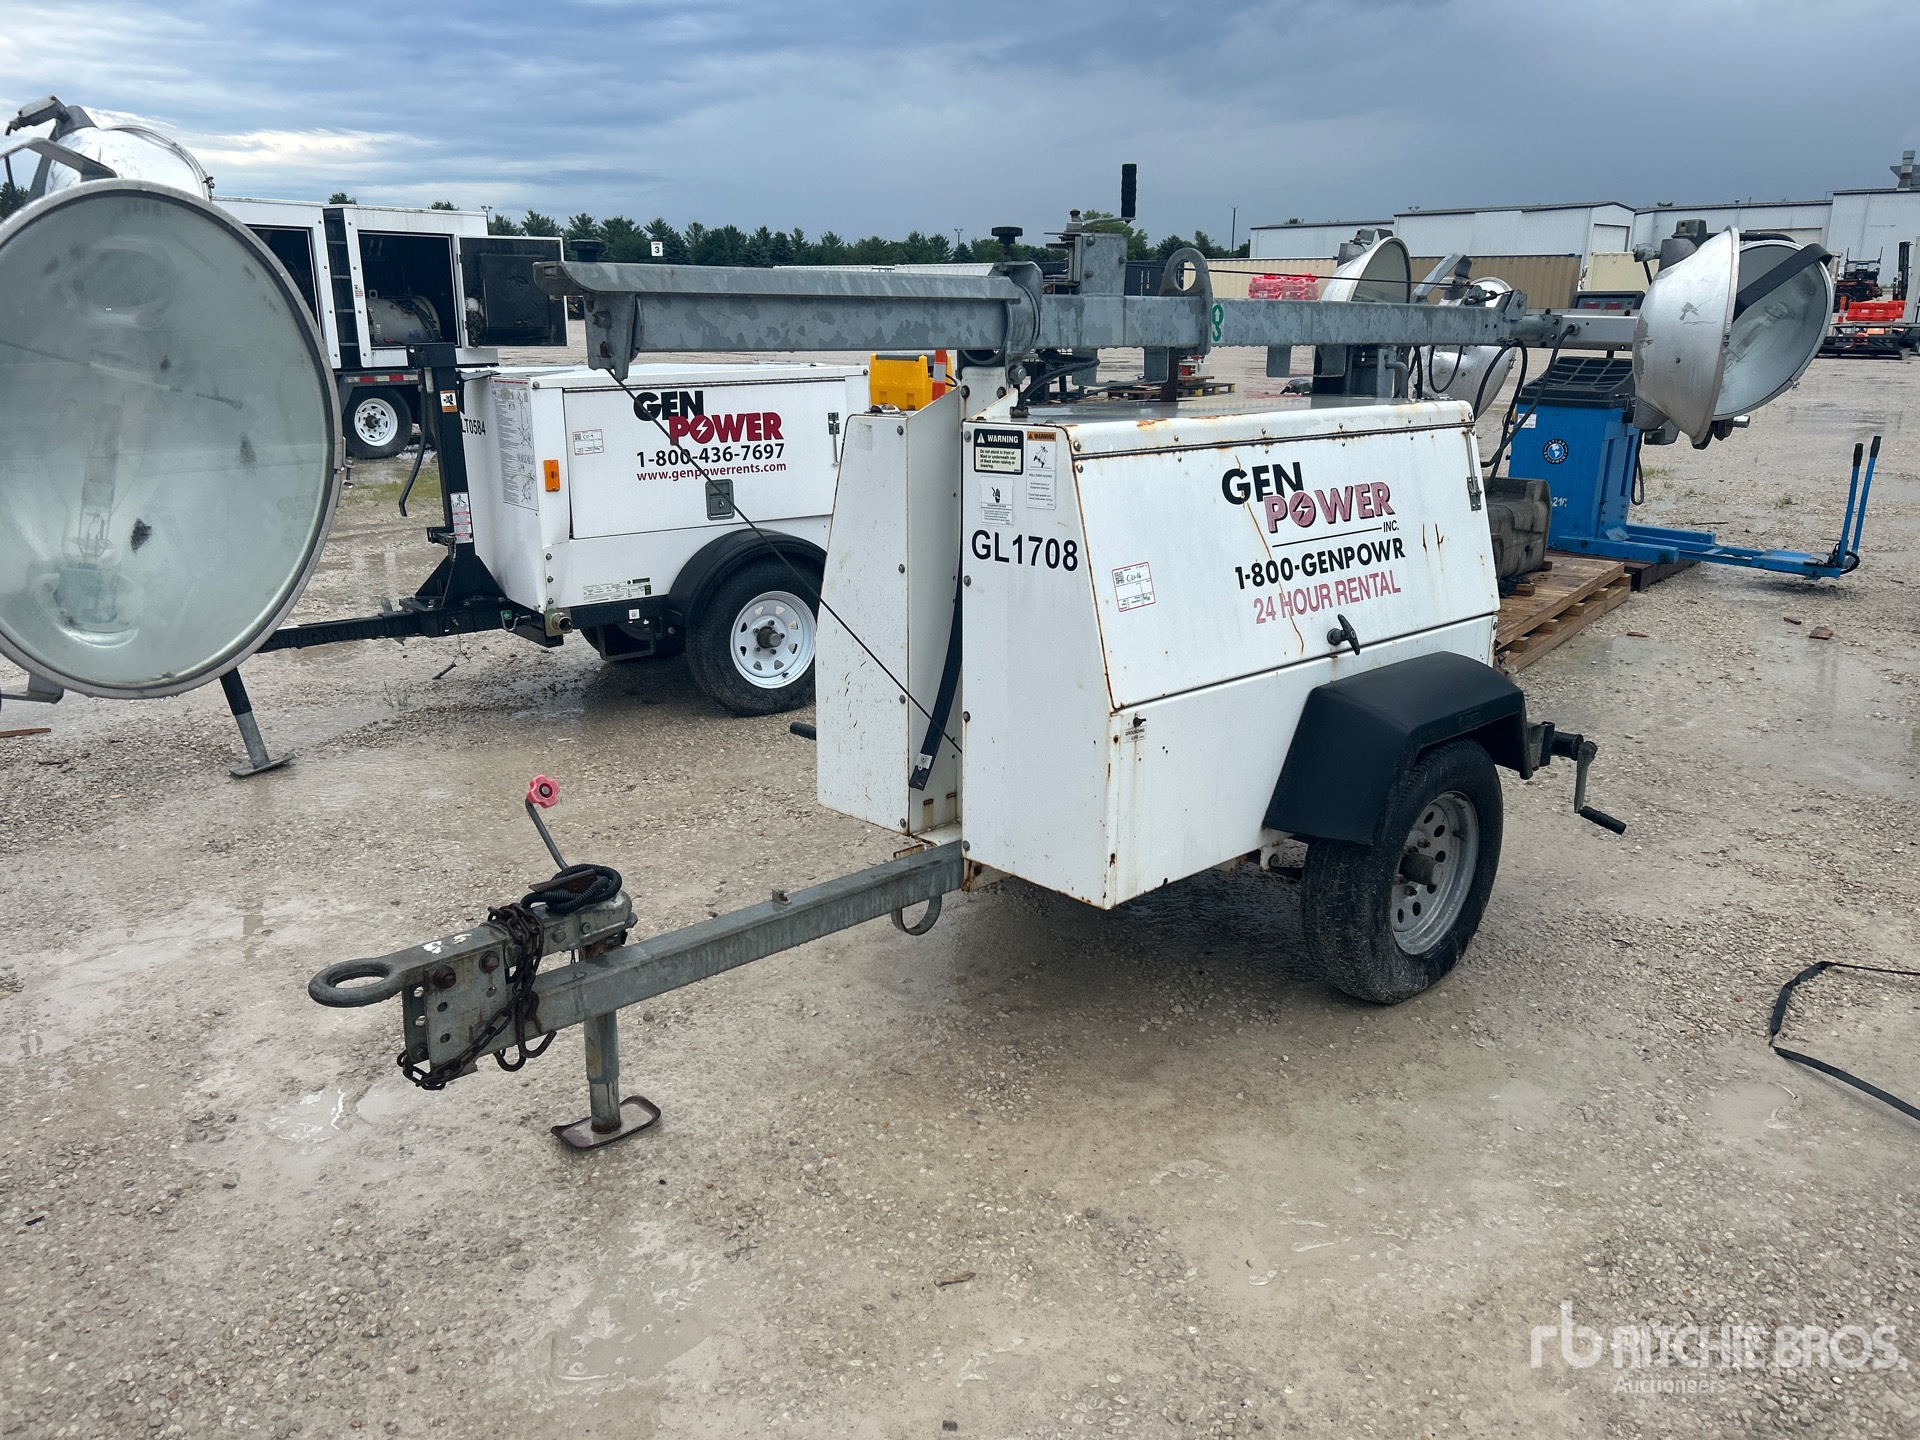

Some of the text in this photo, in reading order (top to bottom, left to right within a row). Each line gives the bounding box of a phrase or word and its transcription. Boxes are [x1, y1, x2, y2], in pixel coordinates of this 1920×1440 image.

[633, 391, 704, 422] GEN
[669, 412, 784, 446] POWER
[987, 434, 1018, 444] WARNING
[636, 443, 785, 468] 1-800-436-7697
[637, 461, 787, 482] www.genpowerrents.com
[1221, 461, 1304, 505] GEN
[1263, 481, 1396, 534] POWER
[1382, 519, 1399, 533] INC.
[971, 530, 1078, 572] GL1708
[1234, 537, 1406, 590] 1-800-GENPOWR
[1253, 570, 1401, 625] 24 HOUR RENTAL
